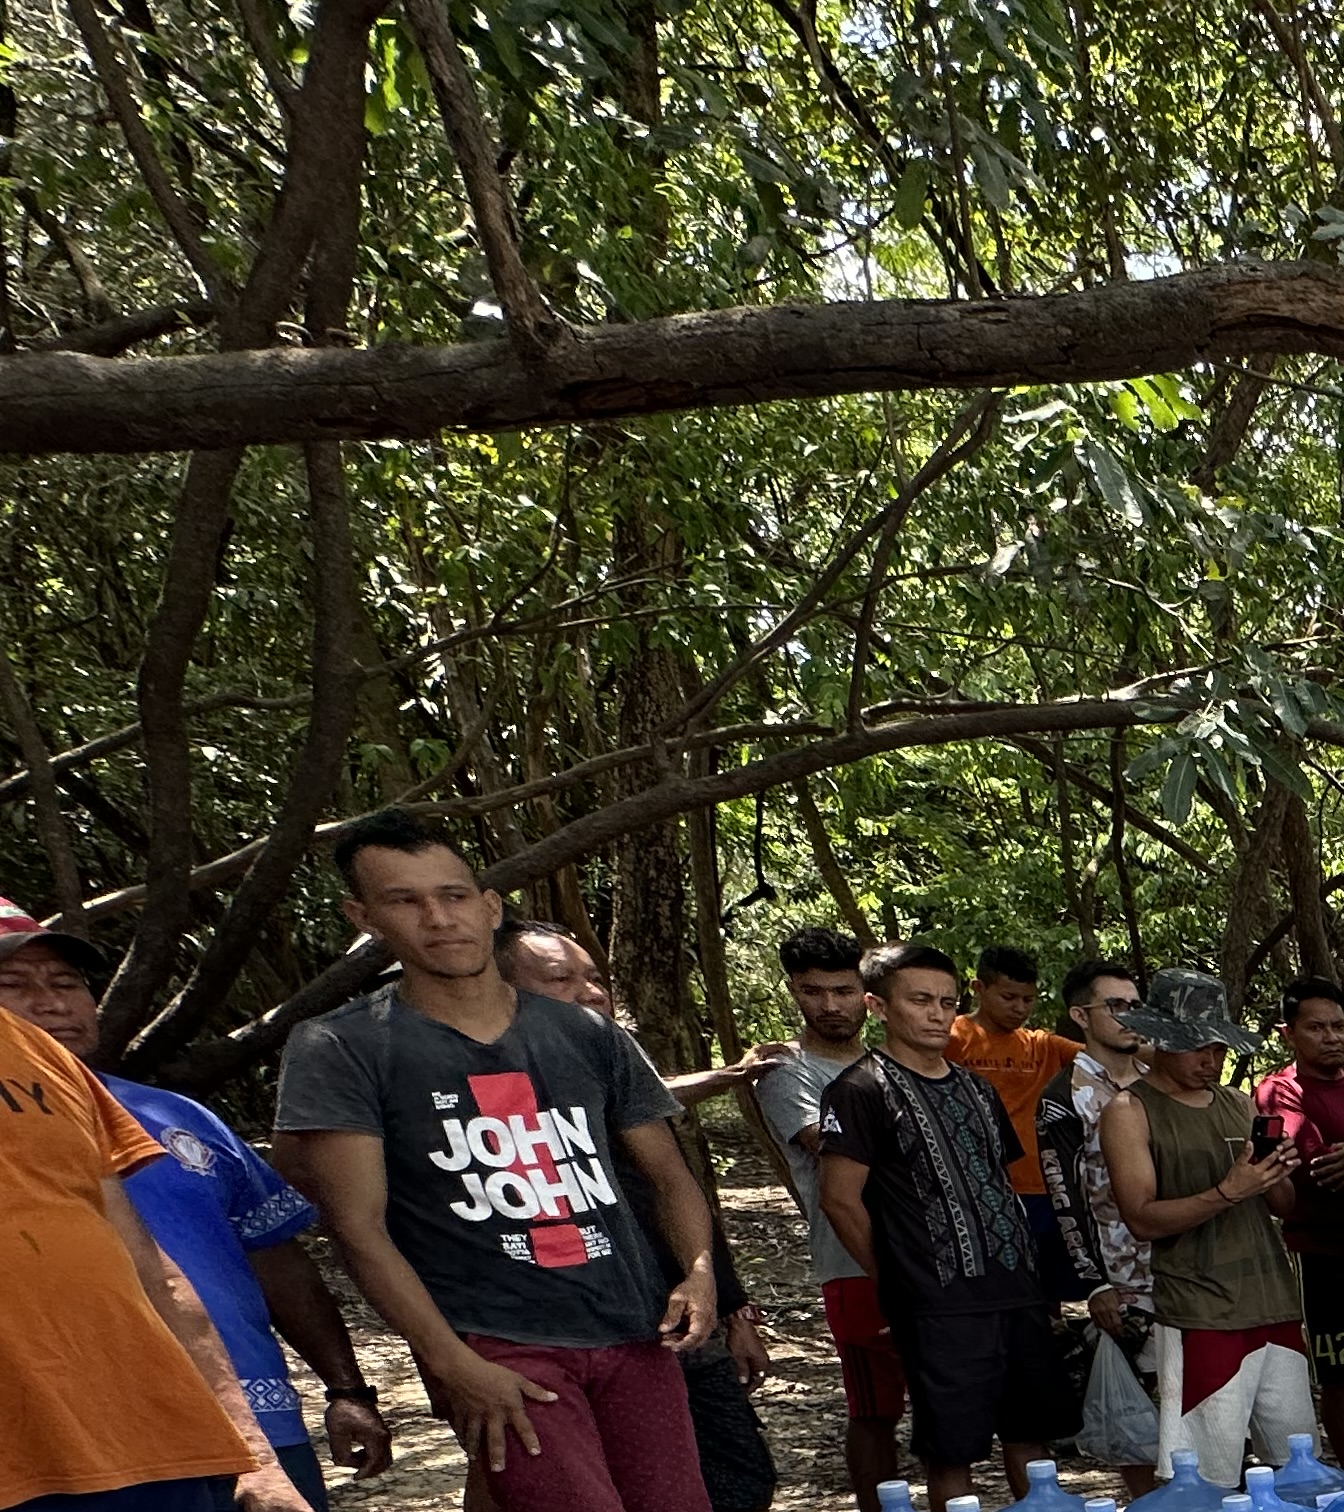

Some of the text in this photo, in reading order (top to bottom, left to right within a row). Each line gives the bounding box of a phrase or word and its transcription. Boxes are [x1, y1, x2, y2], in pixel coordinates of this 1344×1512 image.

[429, 1106, 597, 1171] JOHN
[450, 1157, 617, 1221] JOHN
[1041, 1149, 1102, 1280] KING ARMY
